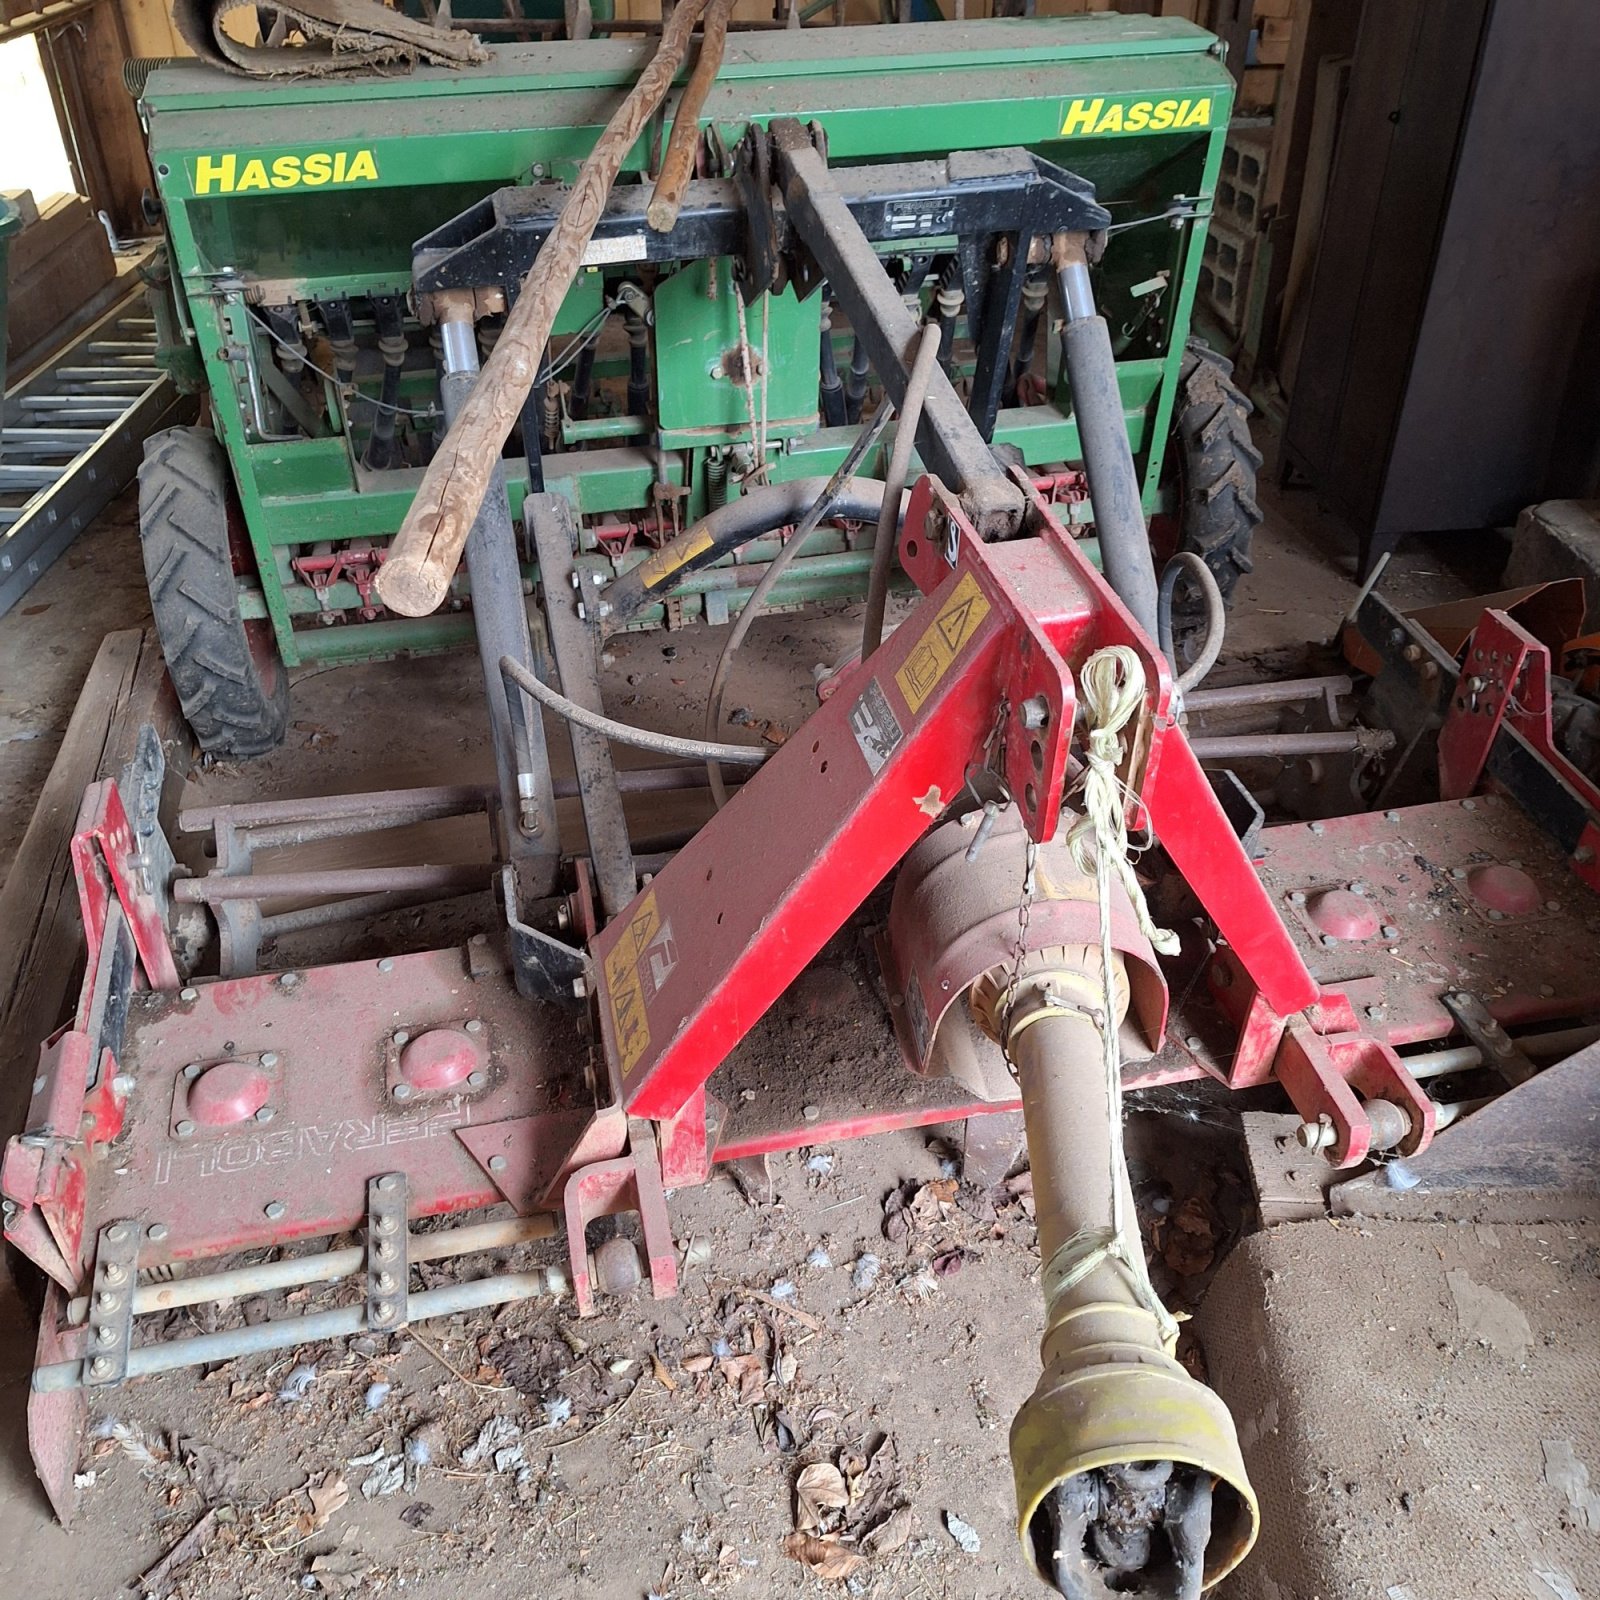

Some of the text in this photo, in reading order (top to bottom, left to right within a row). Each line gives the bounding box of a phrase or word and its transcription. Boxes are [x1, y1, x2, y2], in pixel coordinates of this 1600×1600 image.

[1060, 98, 1211, 135] HASSIA
[195, 150, 379, 195] HASSIA
[154, 1097, 471, 1185] FERABOLI
